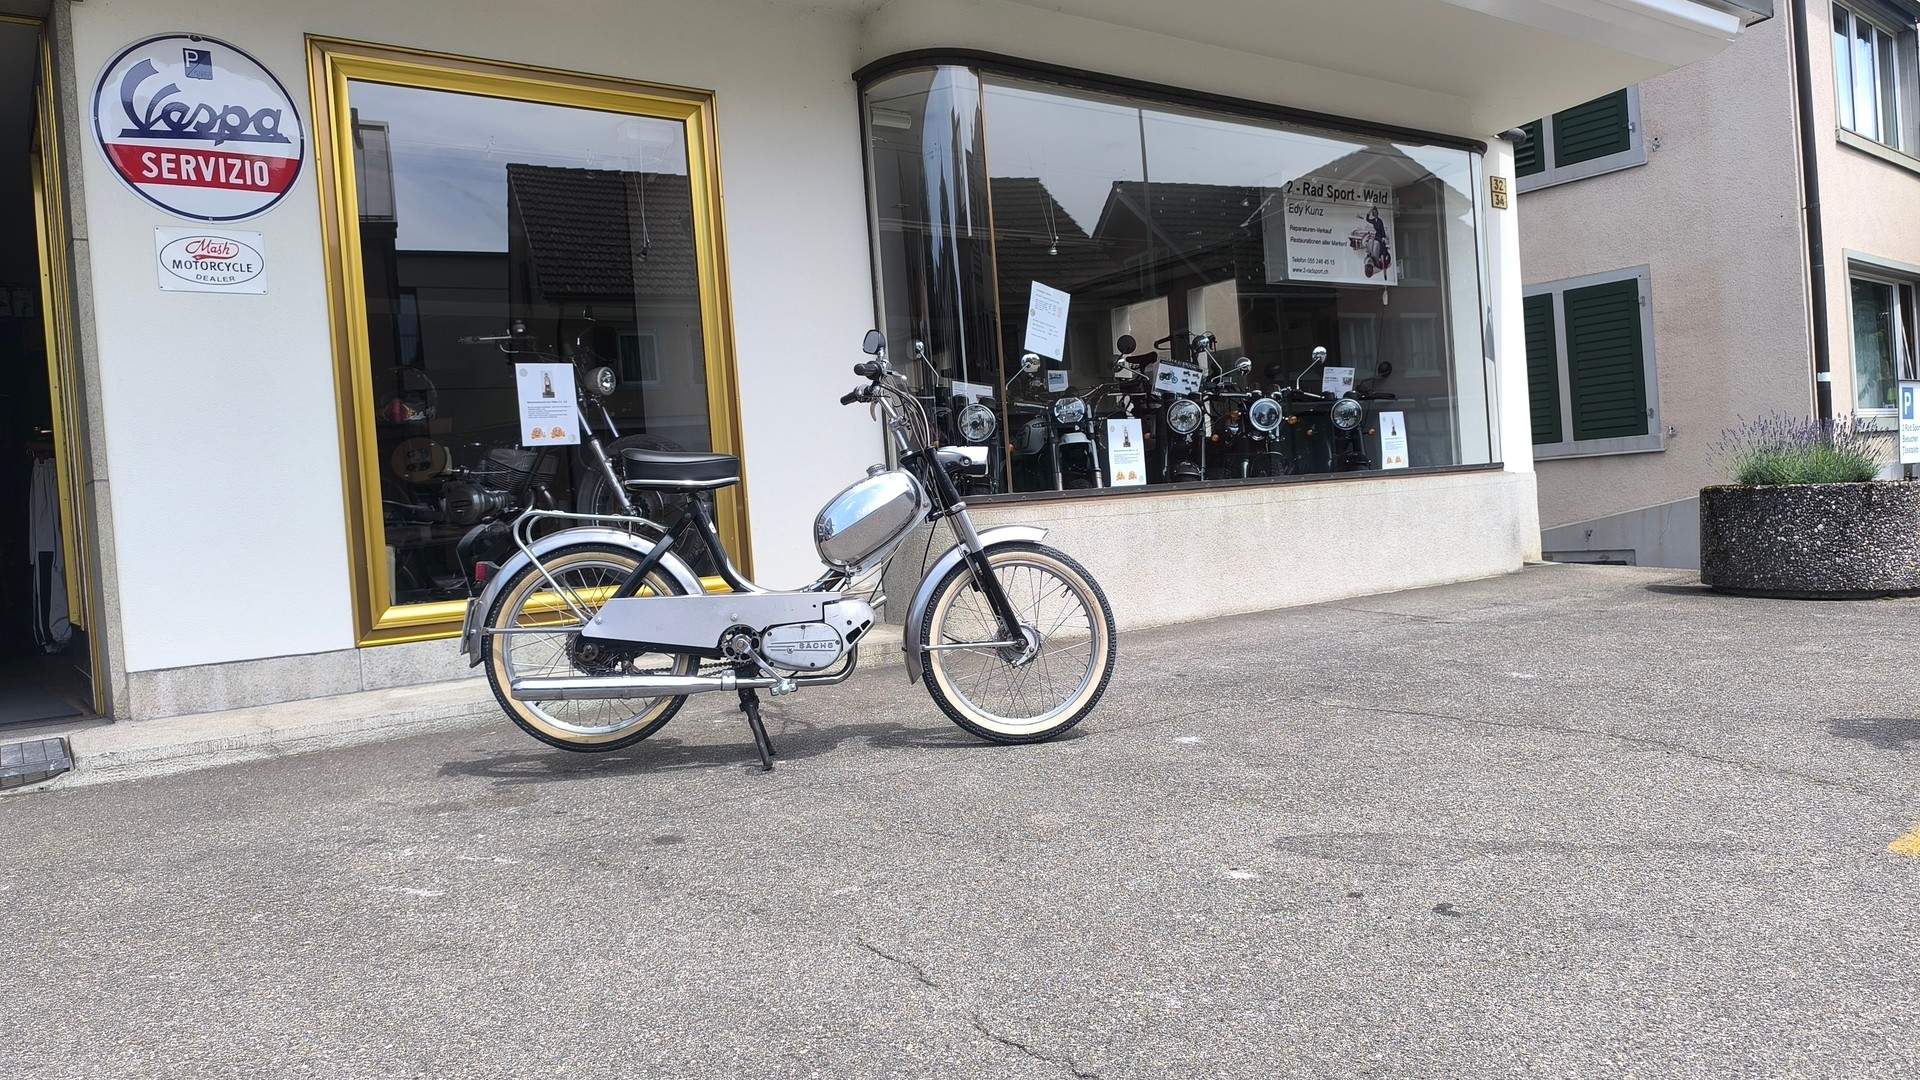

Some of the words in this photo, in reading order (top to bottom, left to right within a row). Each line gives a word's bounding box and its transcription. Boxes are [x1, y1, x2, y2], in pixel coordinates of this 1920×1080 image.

[118, 58, 291, 146] Vespa
[141, 151, 270, 187] SERVIZIO
[1286, 181, 1294, 193] 2
[1302, 182, 1324, 198] Rad
[1326, 184, 1355, 202] Sport
[1363, 189, 1388, 204] Wald
[1493, 178, 1504, 191] 32
[1494, 194, 1505, 207] 34
[1288, 203, 1303, 216] Edy
[1304, 204, 1324, 216] Kunz
[186, 238, 239, 257] Mash
[172, 259, 253, 273] MOTORCYCLE
[195, 273, 236, 283] DEALER
[1903, 391, 1912, 415] P
